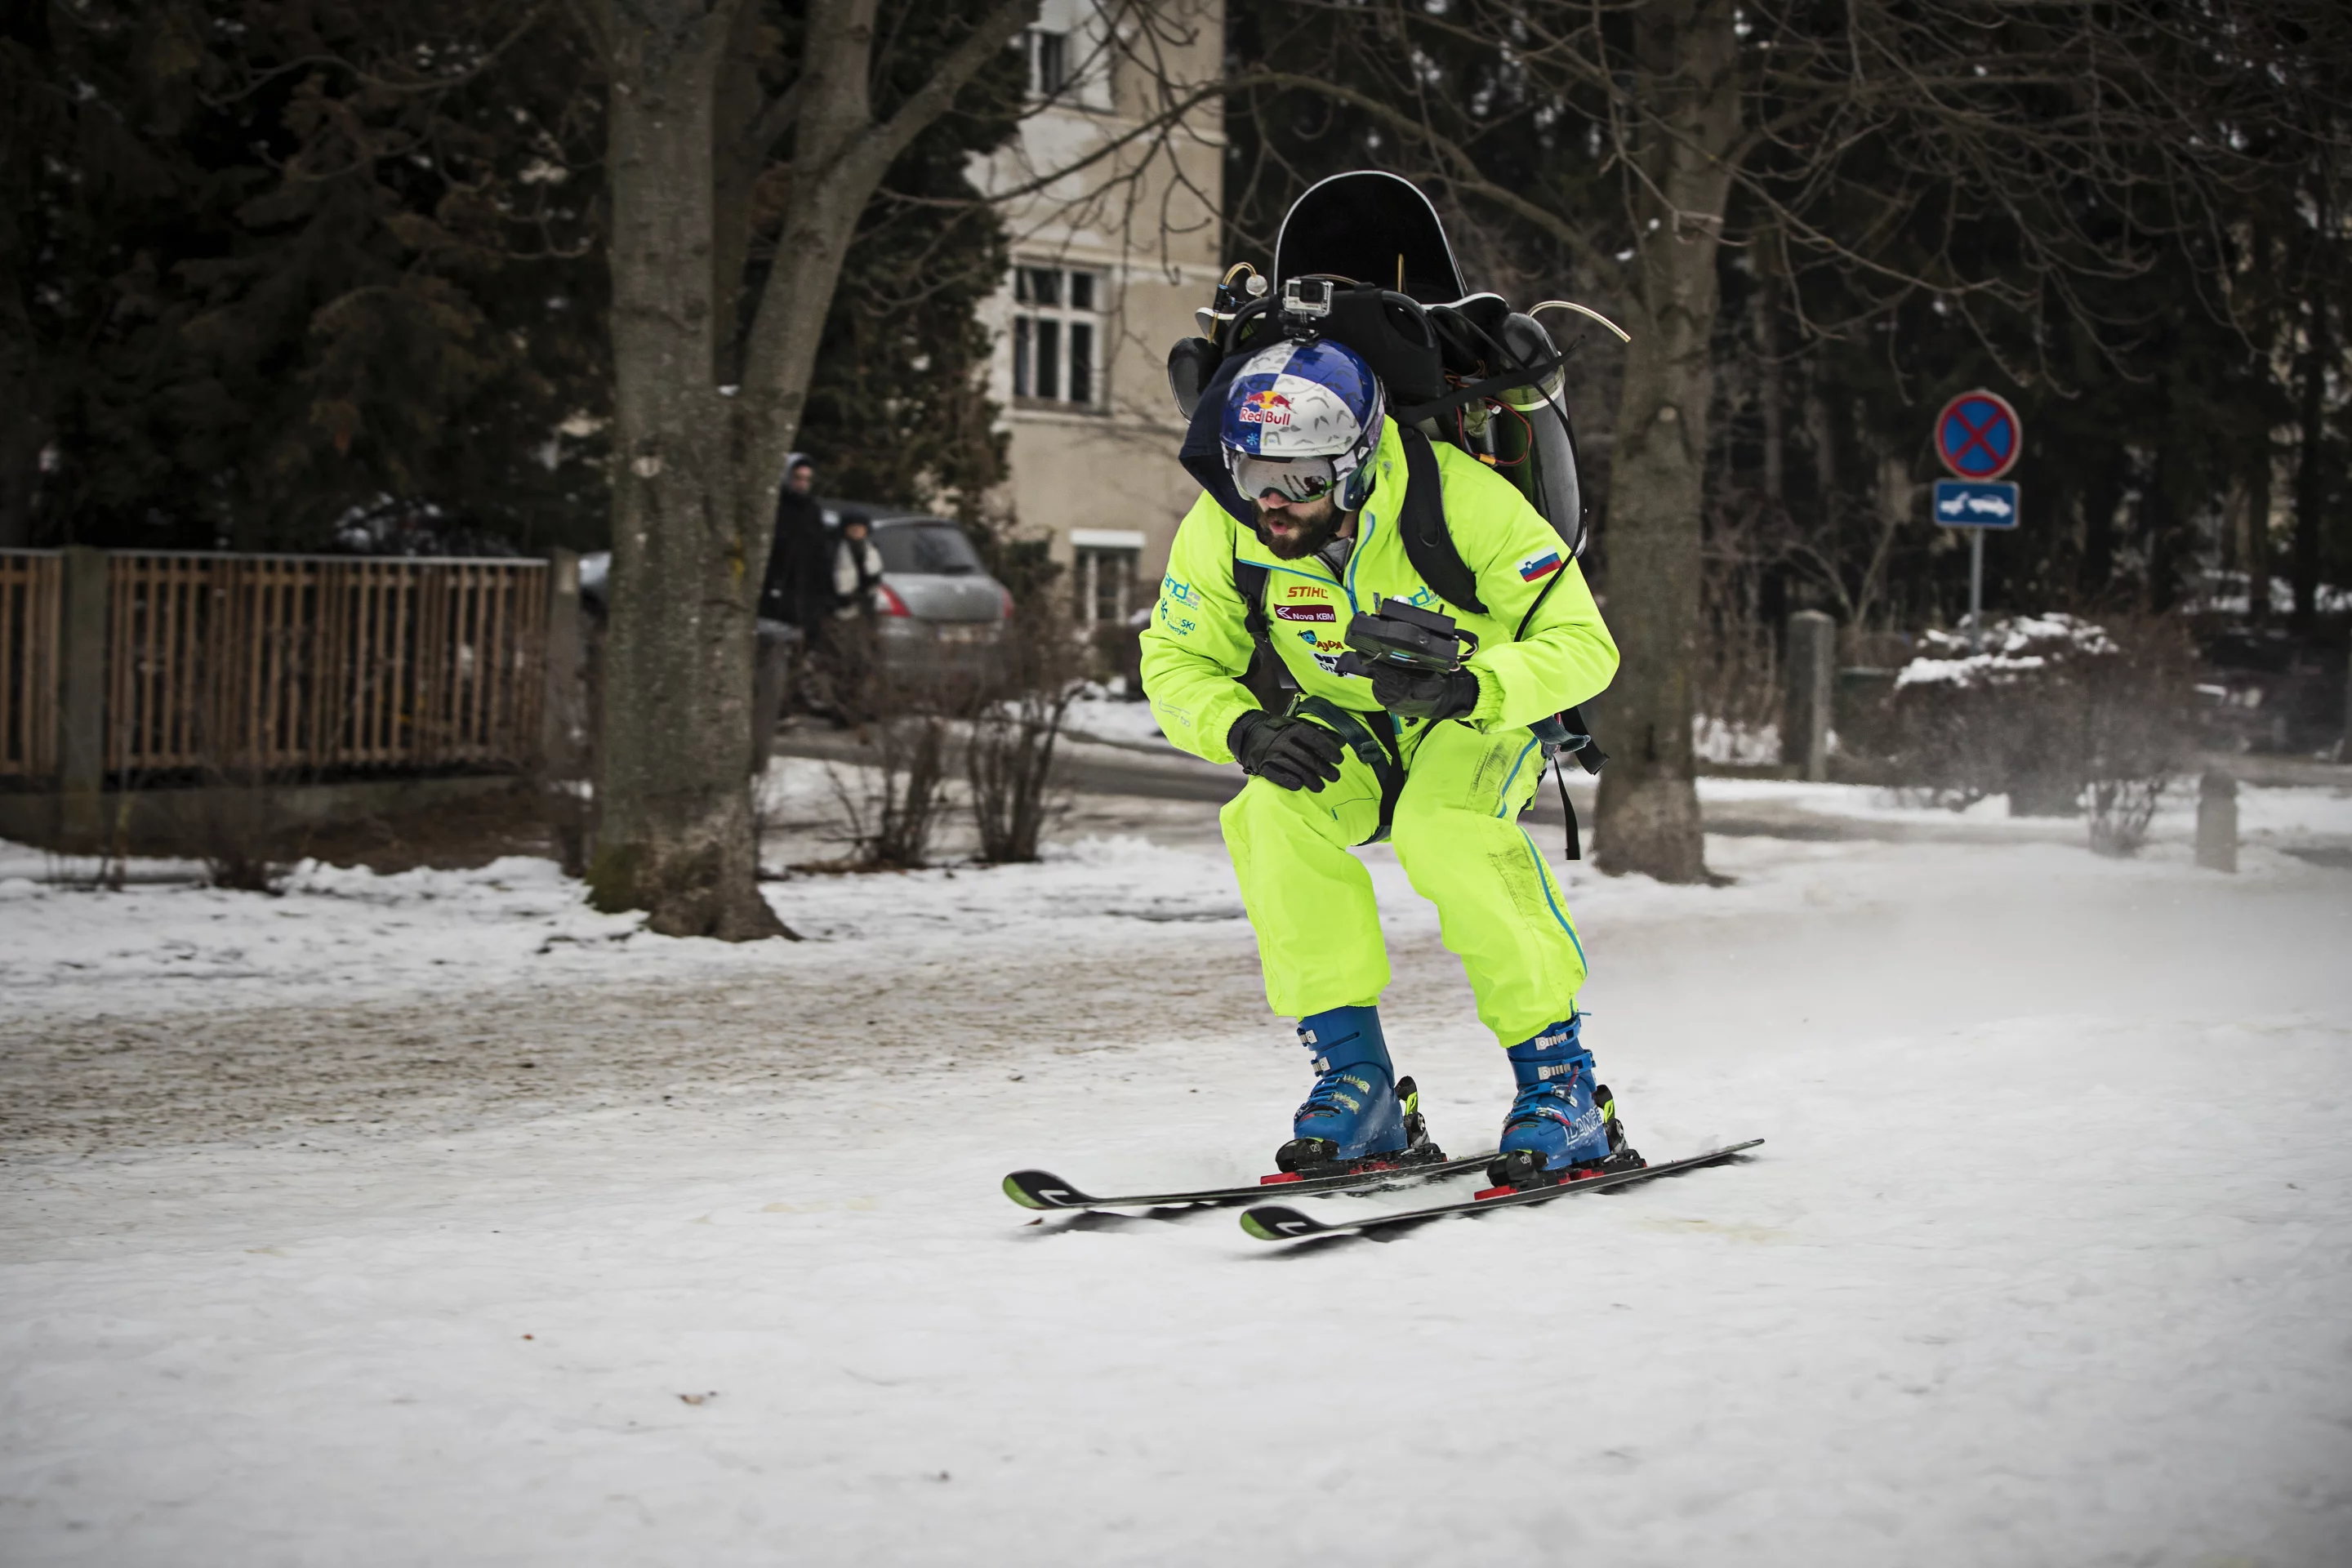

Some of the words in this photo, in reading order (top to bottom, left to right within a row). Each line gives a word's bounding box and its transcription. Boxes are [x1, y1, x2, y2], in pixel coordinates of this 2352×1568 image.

[1240, 408, 1262, 423] Red
[1265, 411, 1290, 425] Bull
[1287, 586, 1328, 599] STIHL
[1562, 1105, 1602, 1146] LANGE
